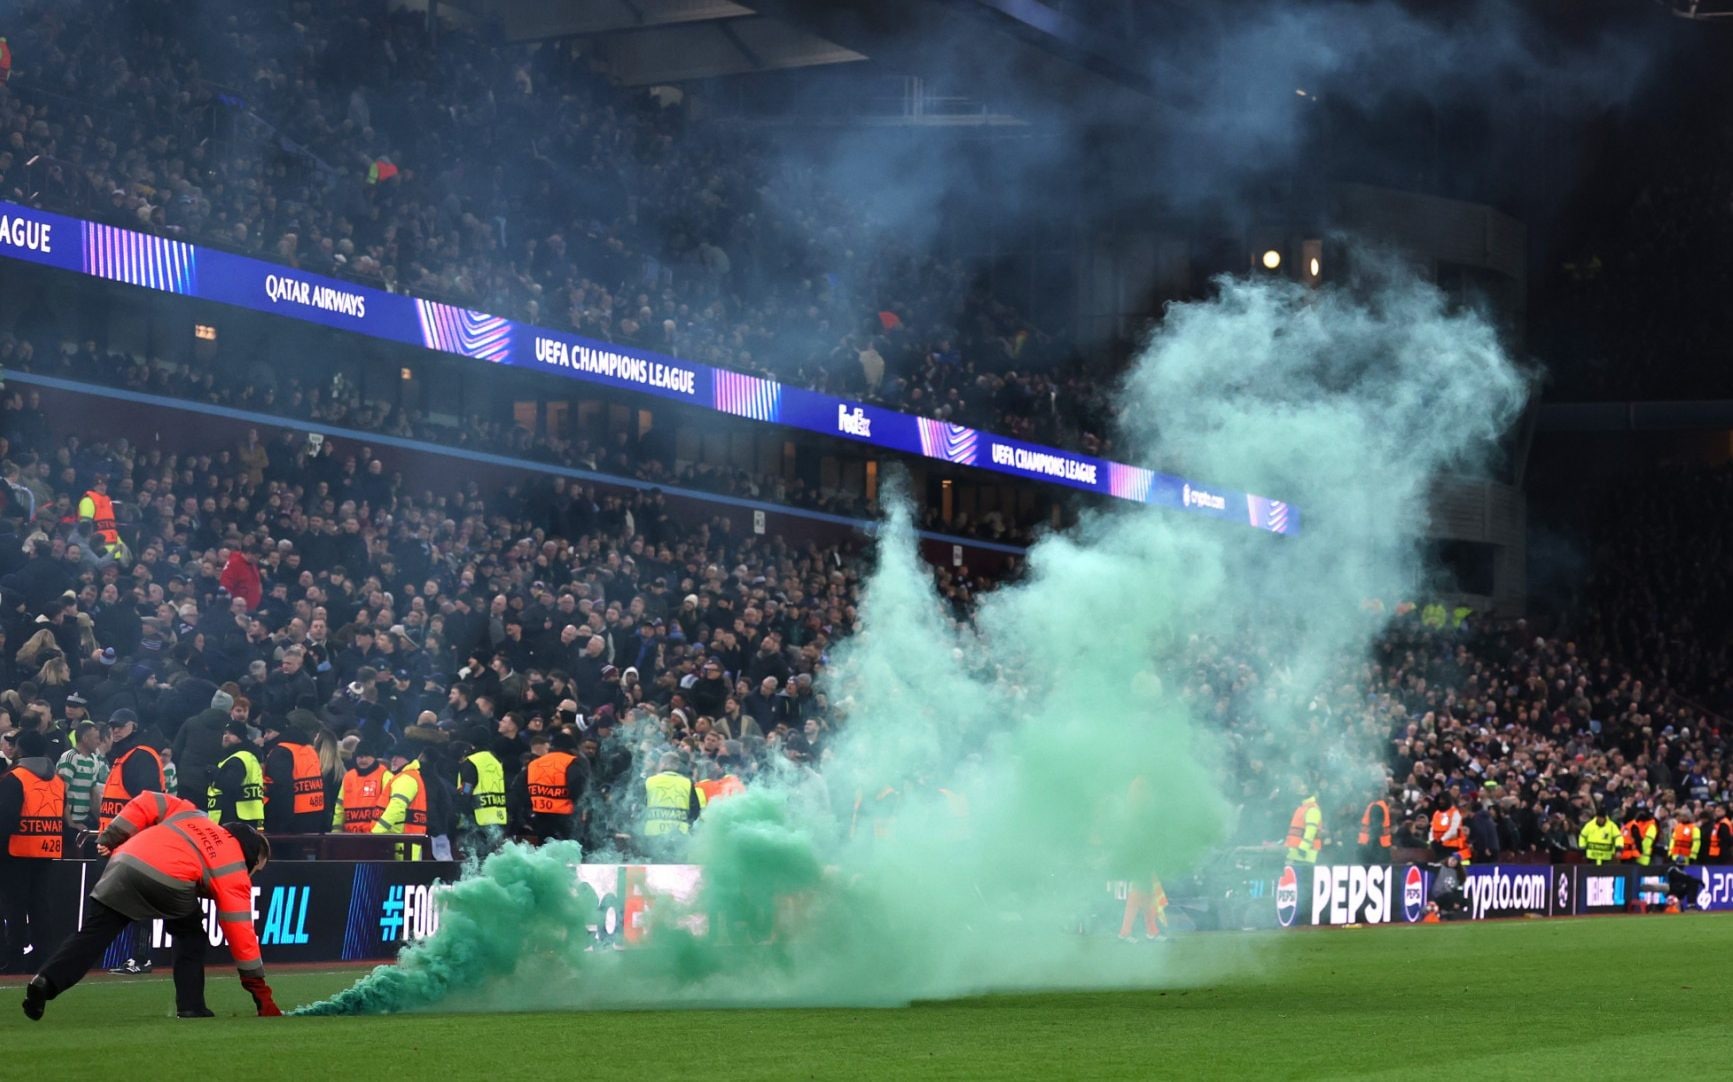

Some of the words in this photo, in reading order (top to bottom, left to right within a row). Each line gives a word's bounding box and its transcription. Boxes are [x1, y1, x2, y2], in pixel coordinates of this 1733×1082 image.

[0, 215, 51, 253] AGUE
[265, 274, 310, 305] QATAR
[311, 285, 365, 318] AIRWAYS
[535, 337, 569, 367] UEFA
[571, 345, 647, 383] CHAMPIONS
[649, 362, 695, 395] LEAGUE
[838, 404, 871, 437] FedEx
[992, 443, 1015, 466] UEFA
[1015, 448, 1065, 477] CHAMPIONS
[1065, 459, 1097, 484] LEAGUE
[41, 840, 61, 853] 428
[187, 823, 217, 859] OFFICER
[205, 827, 223, 847] FIRE
[1311, 865, 1393, 925] PEPSI
[1463, 866, 1546, 920] rypto.com
[1712, 873, 1733, 903] PS
[261, 886, 311, 945] ALL
[380, 885, 453, 941] #FOO
